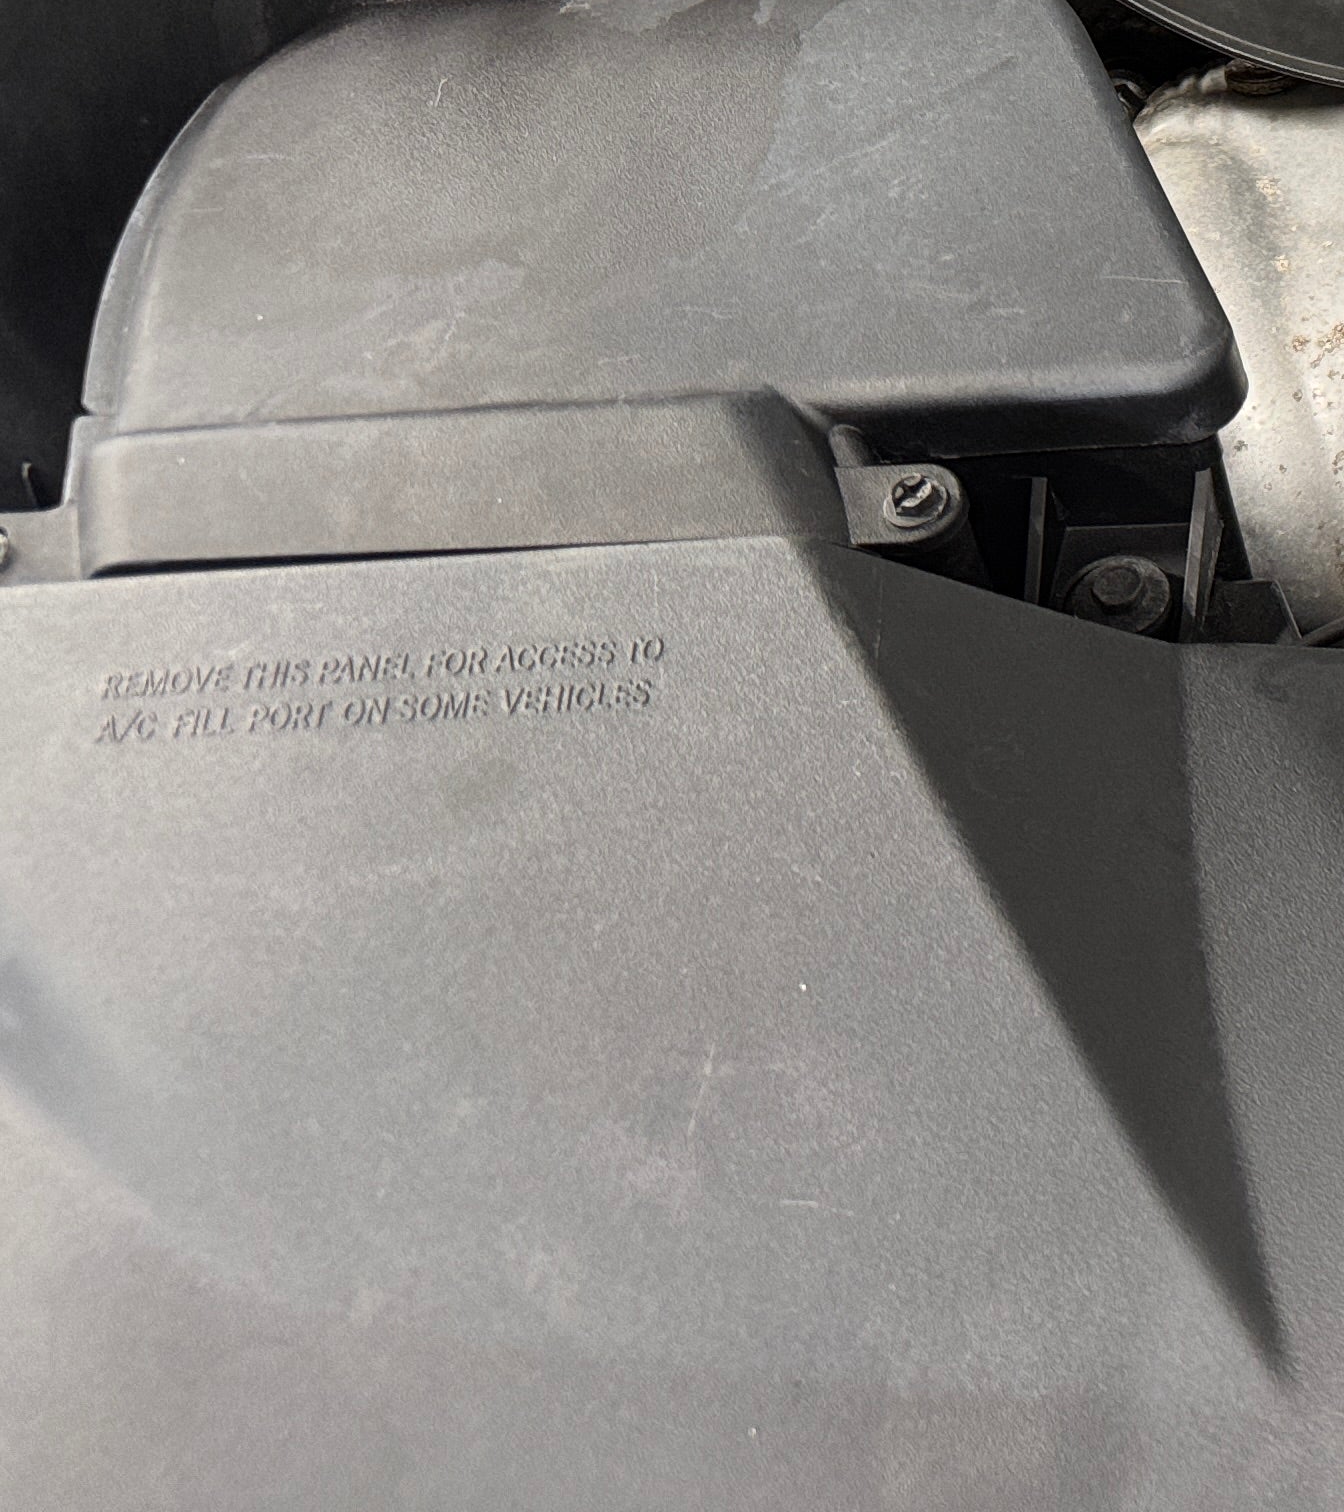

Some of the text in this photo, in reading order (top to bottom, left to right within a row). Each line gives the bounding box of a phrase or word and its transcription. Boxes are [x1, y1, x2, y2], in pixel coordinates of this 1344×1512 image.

[103, 635, 665, 700] REMOVE THIS PANEL FOR ACCESS TO
[95, 678, 653, 744] A/C FILL PORT ON SOME VEHICLES
